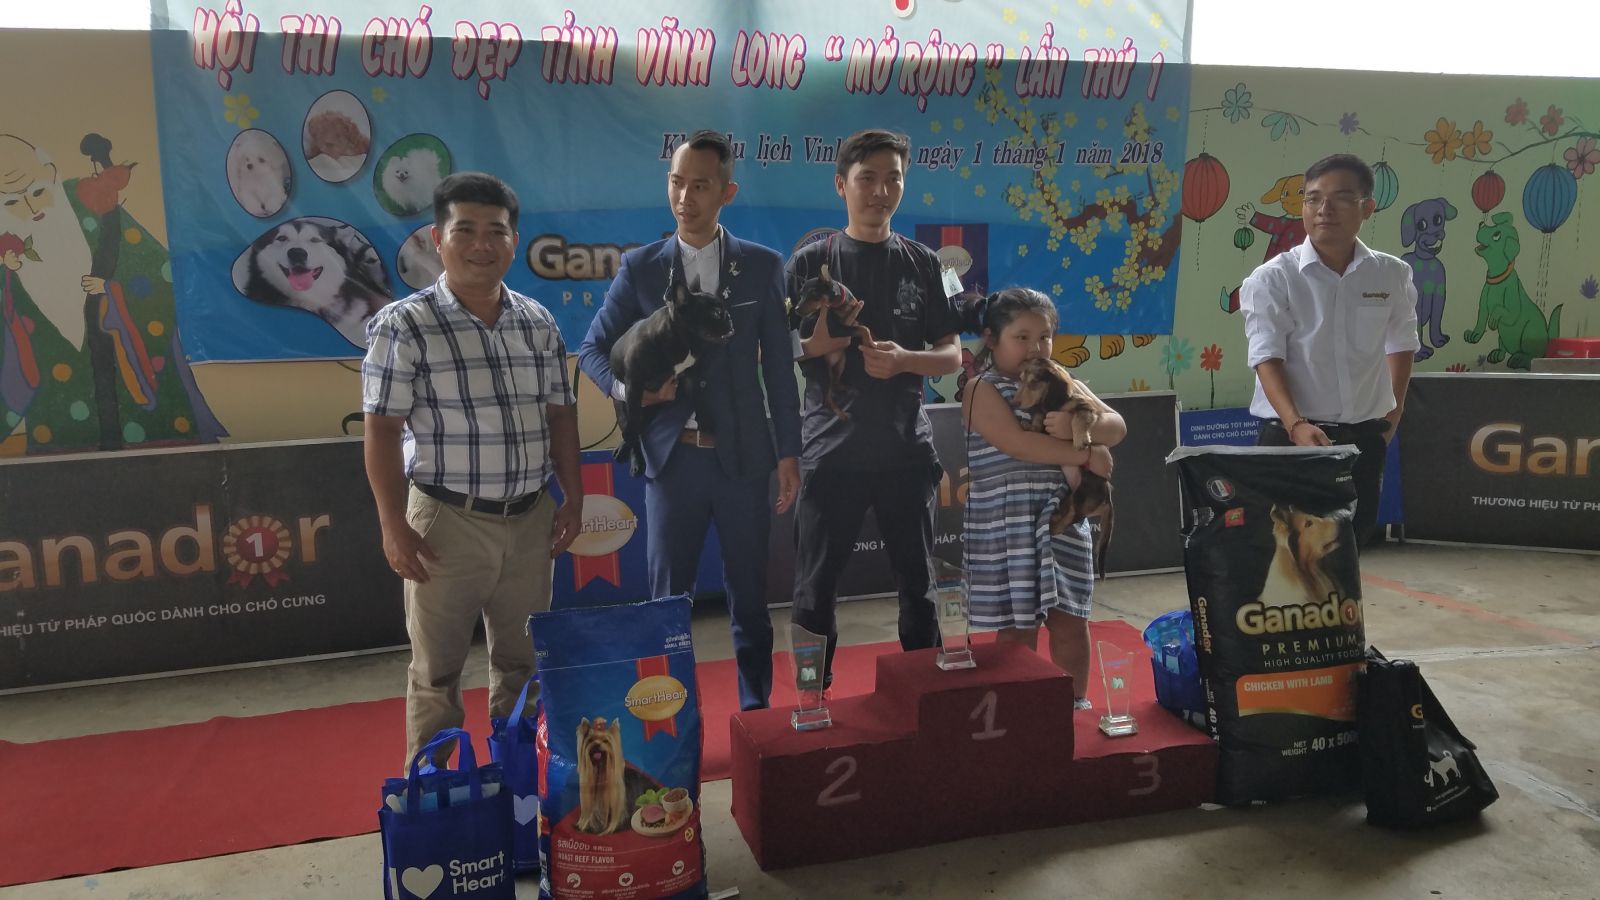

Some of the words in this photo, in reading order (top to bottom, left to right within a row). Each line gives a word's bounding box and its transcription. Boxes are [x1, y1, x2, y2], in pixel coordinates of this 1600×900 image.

[193, 0, 260, 91] HỘI
[280, 14, 341, 76] THI
[360, 4, 433, 79] CHÓ
[451, 20, 522, 100] ĐẸP
[541, 10, 619, 85] TỈNH
[635, 16, 715, 87] VĨNH
[730, 27, 806, 94] LONG
[1014, 22, 1070, 98] LẦN
[1081, 37, 1138, 99] THỨ
[1146, 51, 1166, 101] 1
[756, 134, 793, 167] lịch
[916, 144, 963, 171] ngày
[971, 142, 983, 165] 1
[992, 143, 1048, 171] tháng
[1055, 142, 1065, 165] 1
[1074, 142, 1112, 165] năm
[1122, 142, 1164, 165] 2018
[1472, 496, 1526, 508] THƯƠNG
[1529, 498, 1558, 510] HIỆU
[1562, 499, 1581, 510] TỪ
[1583, 501, 1600, 511] PH
[581, 514, 638, 533] rtHeart
[0, 504, 331, 592] anador
[934, 532, 956, 545] HÁP
[38, 619, 60, 633] TỪ
[65, 615, 107, 631] PHÁP
[112, 610, 156, 626] QUỐC
[161, 606, 205, 621] DÀNH
[209, 602, 241, 617] CHO
[245, 597, 278, 612] CHÓ
[282, 593, 327, 609] CƯNG
[1262, 634, 1358, 656] PREMIUM
[1264, 658, 1290, 668] HIGH
[1294, 653, 1334, 665] QUALITY
[1244, 681, 1284, 692] CHICKEN
[1287, 679, 1308, 689] WITH
[1310, 675, 1333, 686] LAMB
[624, 687, 688, 707] SmartHeart
[969, 690, 1008, 740] 1
[1281, 747, 1307, 757] WEIGHT
[1293, 740, 1307, 748] NET
[1311, 736, 1326, 752] 40
[816, 755, 862, 806] 2
[1127, 754, 1162, 796] 3
[449, 850, 505, 877] Smart
[574, 855, 590, 863] BEEF
[591, 856, 614, 864] FLAVOR
[452, 869, 504, 895] Heart
